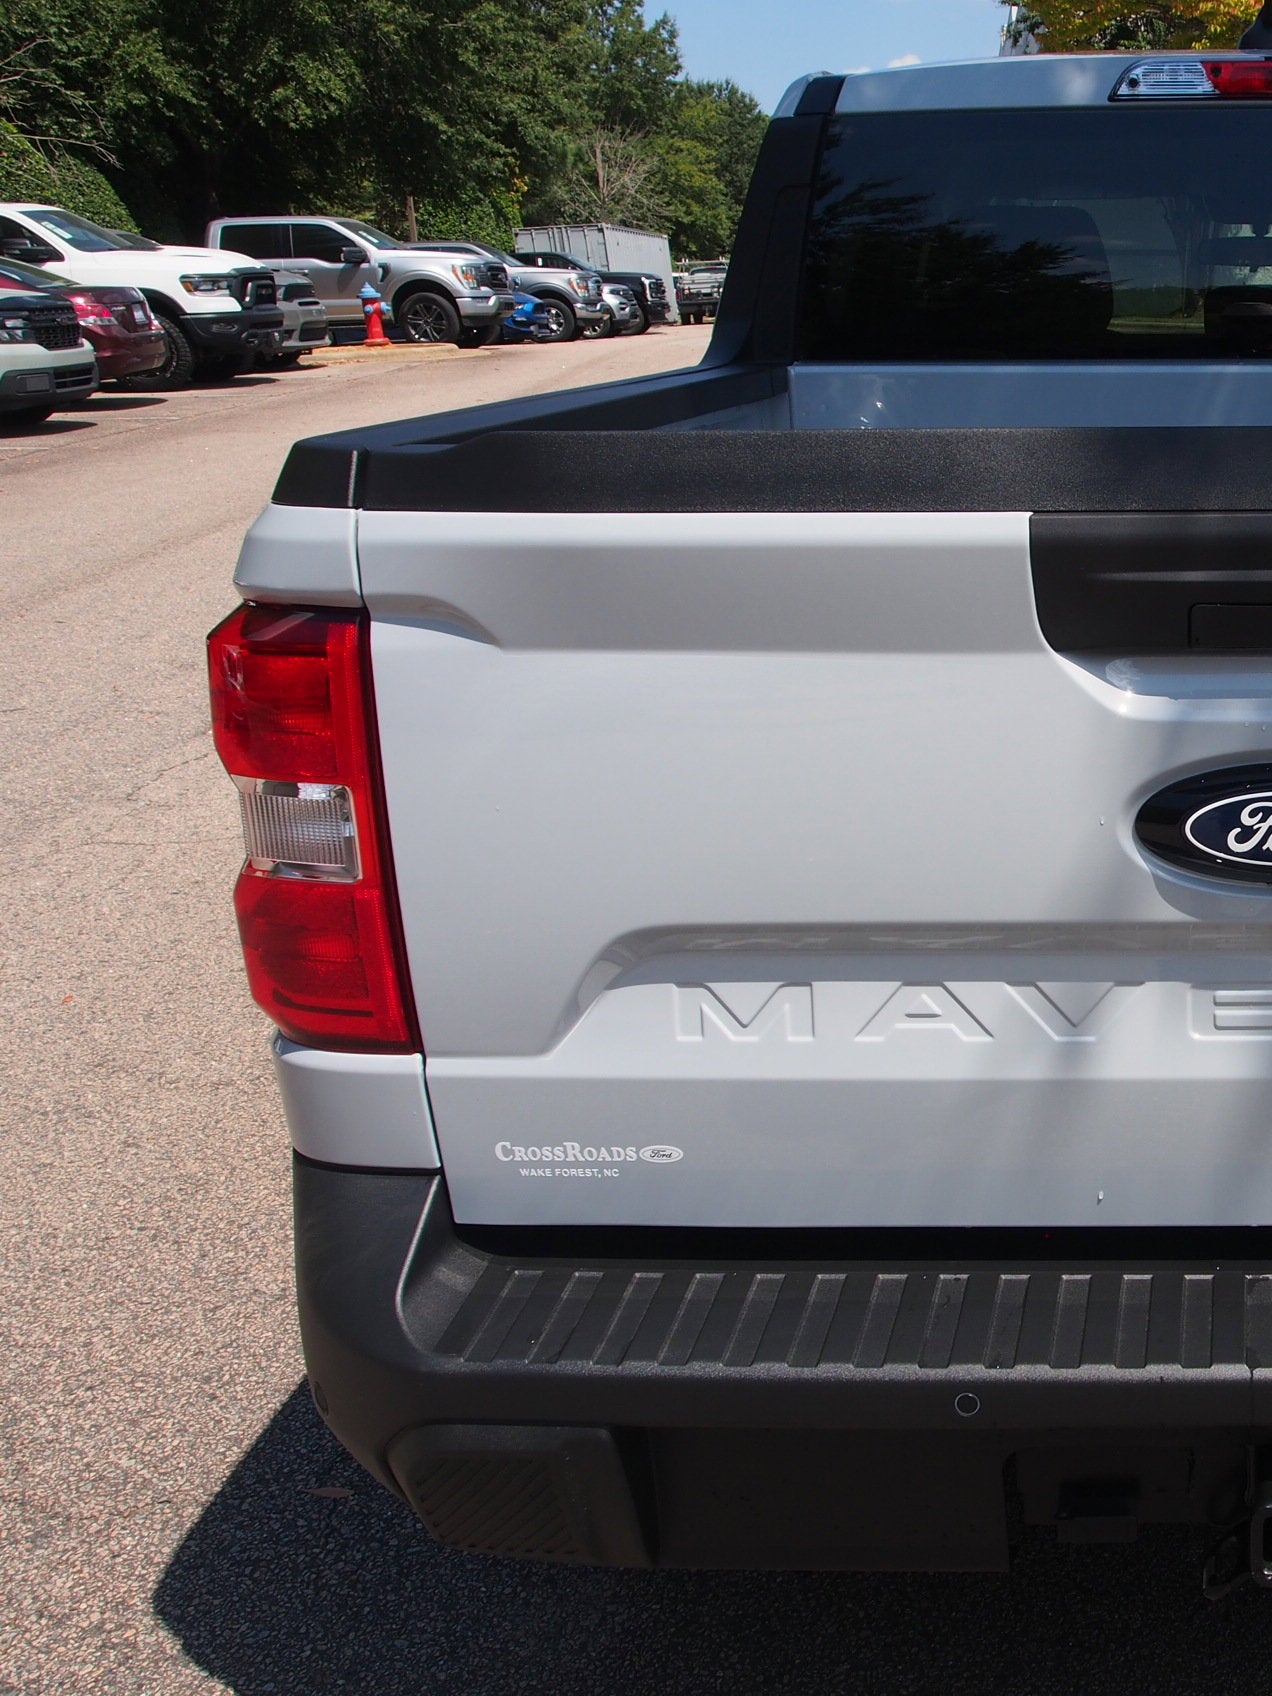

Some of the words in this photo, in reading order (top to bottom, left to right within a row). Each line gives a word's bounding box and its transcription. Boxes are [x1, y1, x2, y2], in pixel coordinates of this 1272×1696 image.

[519, 1168, 553, 1177] WAKE
[555, 1168, 601, 1178] FOREST,
[603, 1168, 620, 1177] NC
